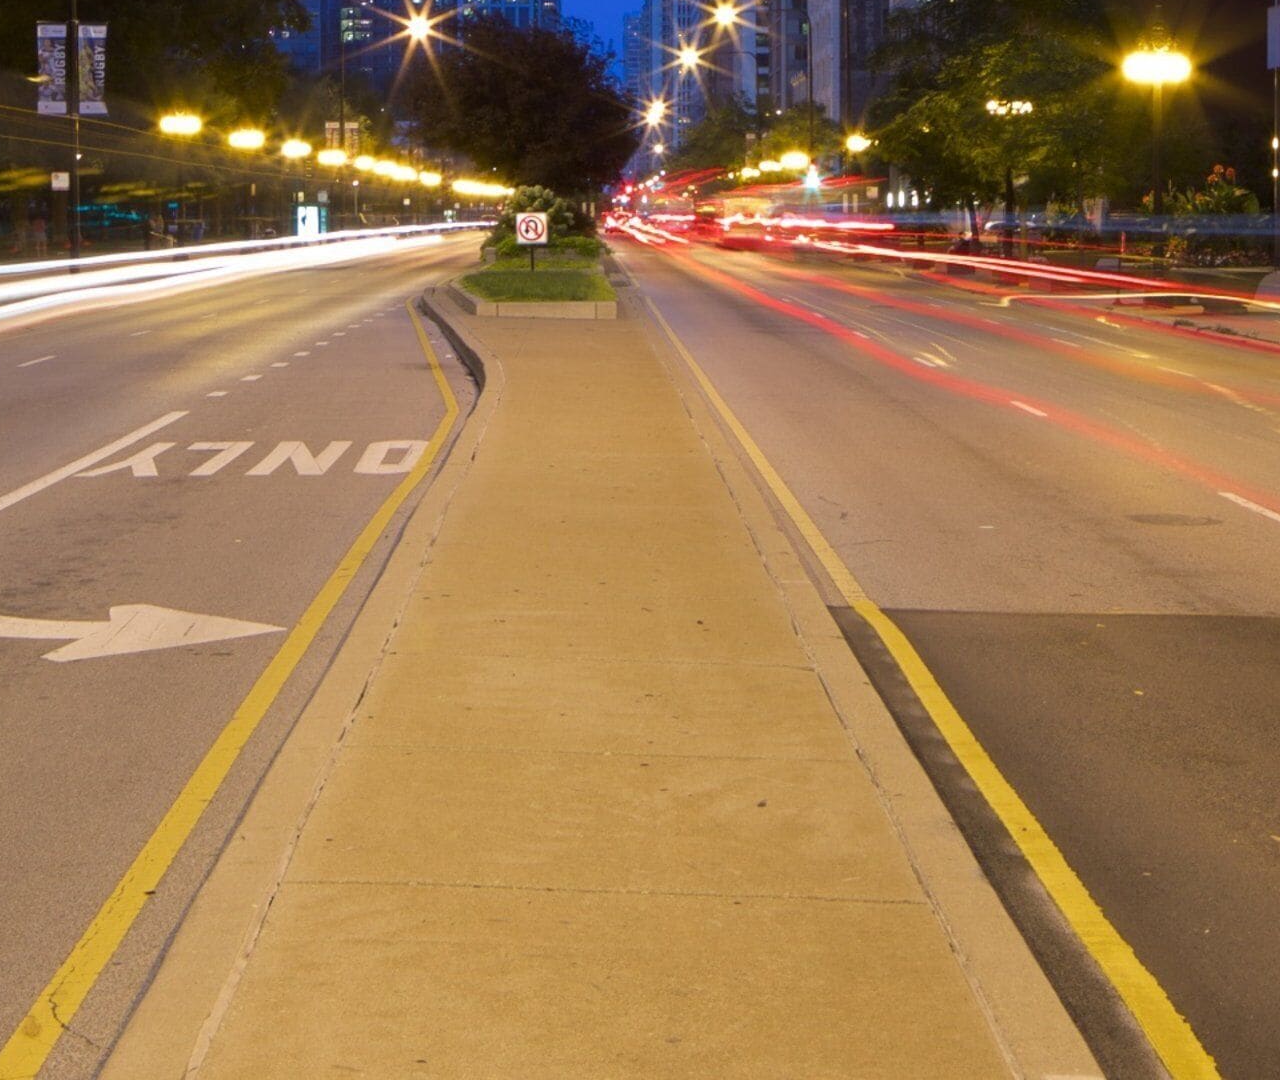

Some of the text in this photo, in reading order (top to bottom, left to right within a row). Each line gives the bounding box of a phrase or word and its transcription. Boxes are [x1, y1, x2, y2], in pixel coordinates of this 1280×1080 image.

[54, 43, 66, 85] RUGBY
[94, 45, 106, 88] RUGBY
[73, 439, 431, 478] ONLY
